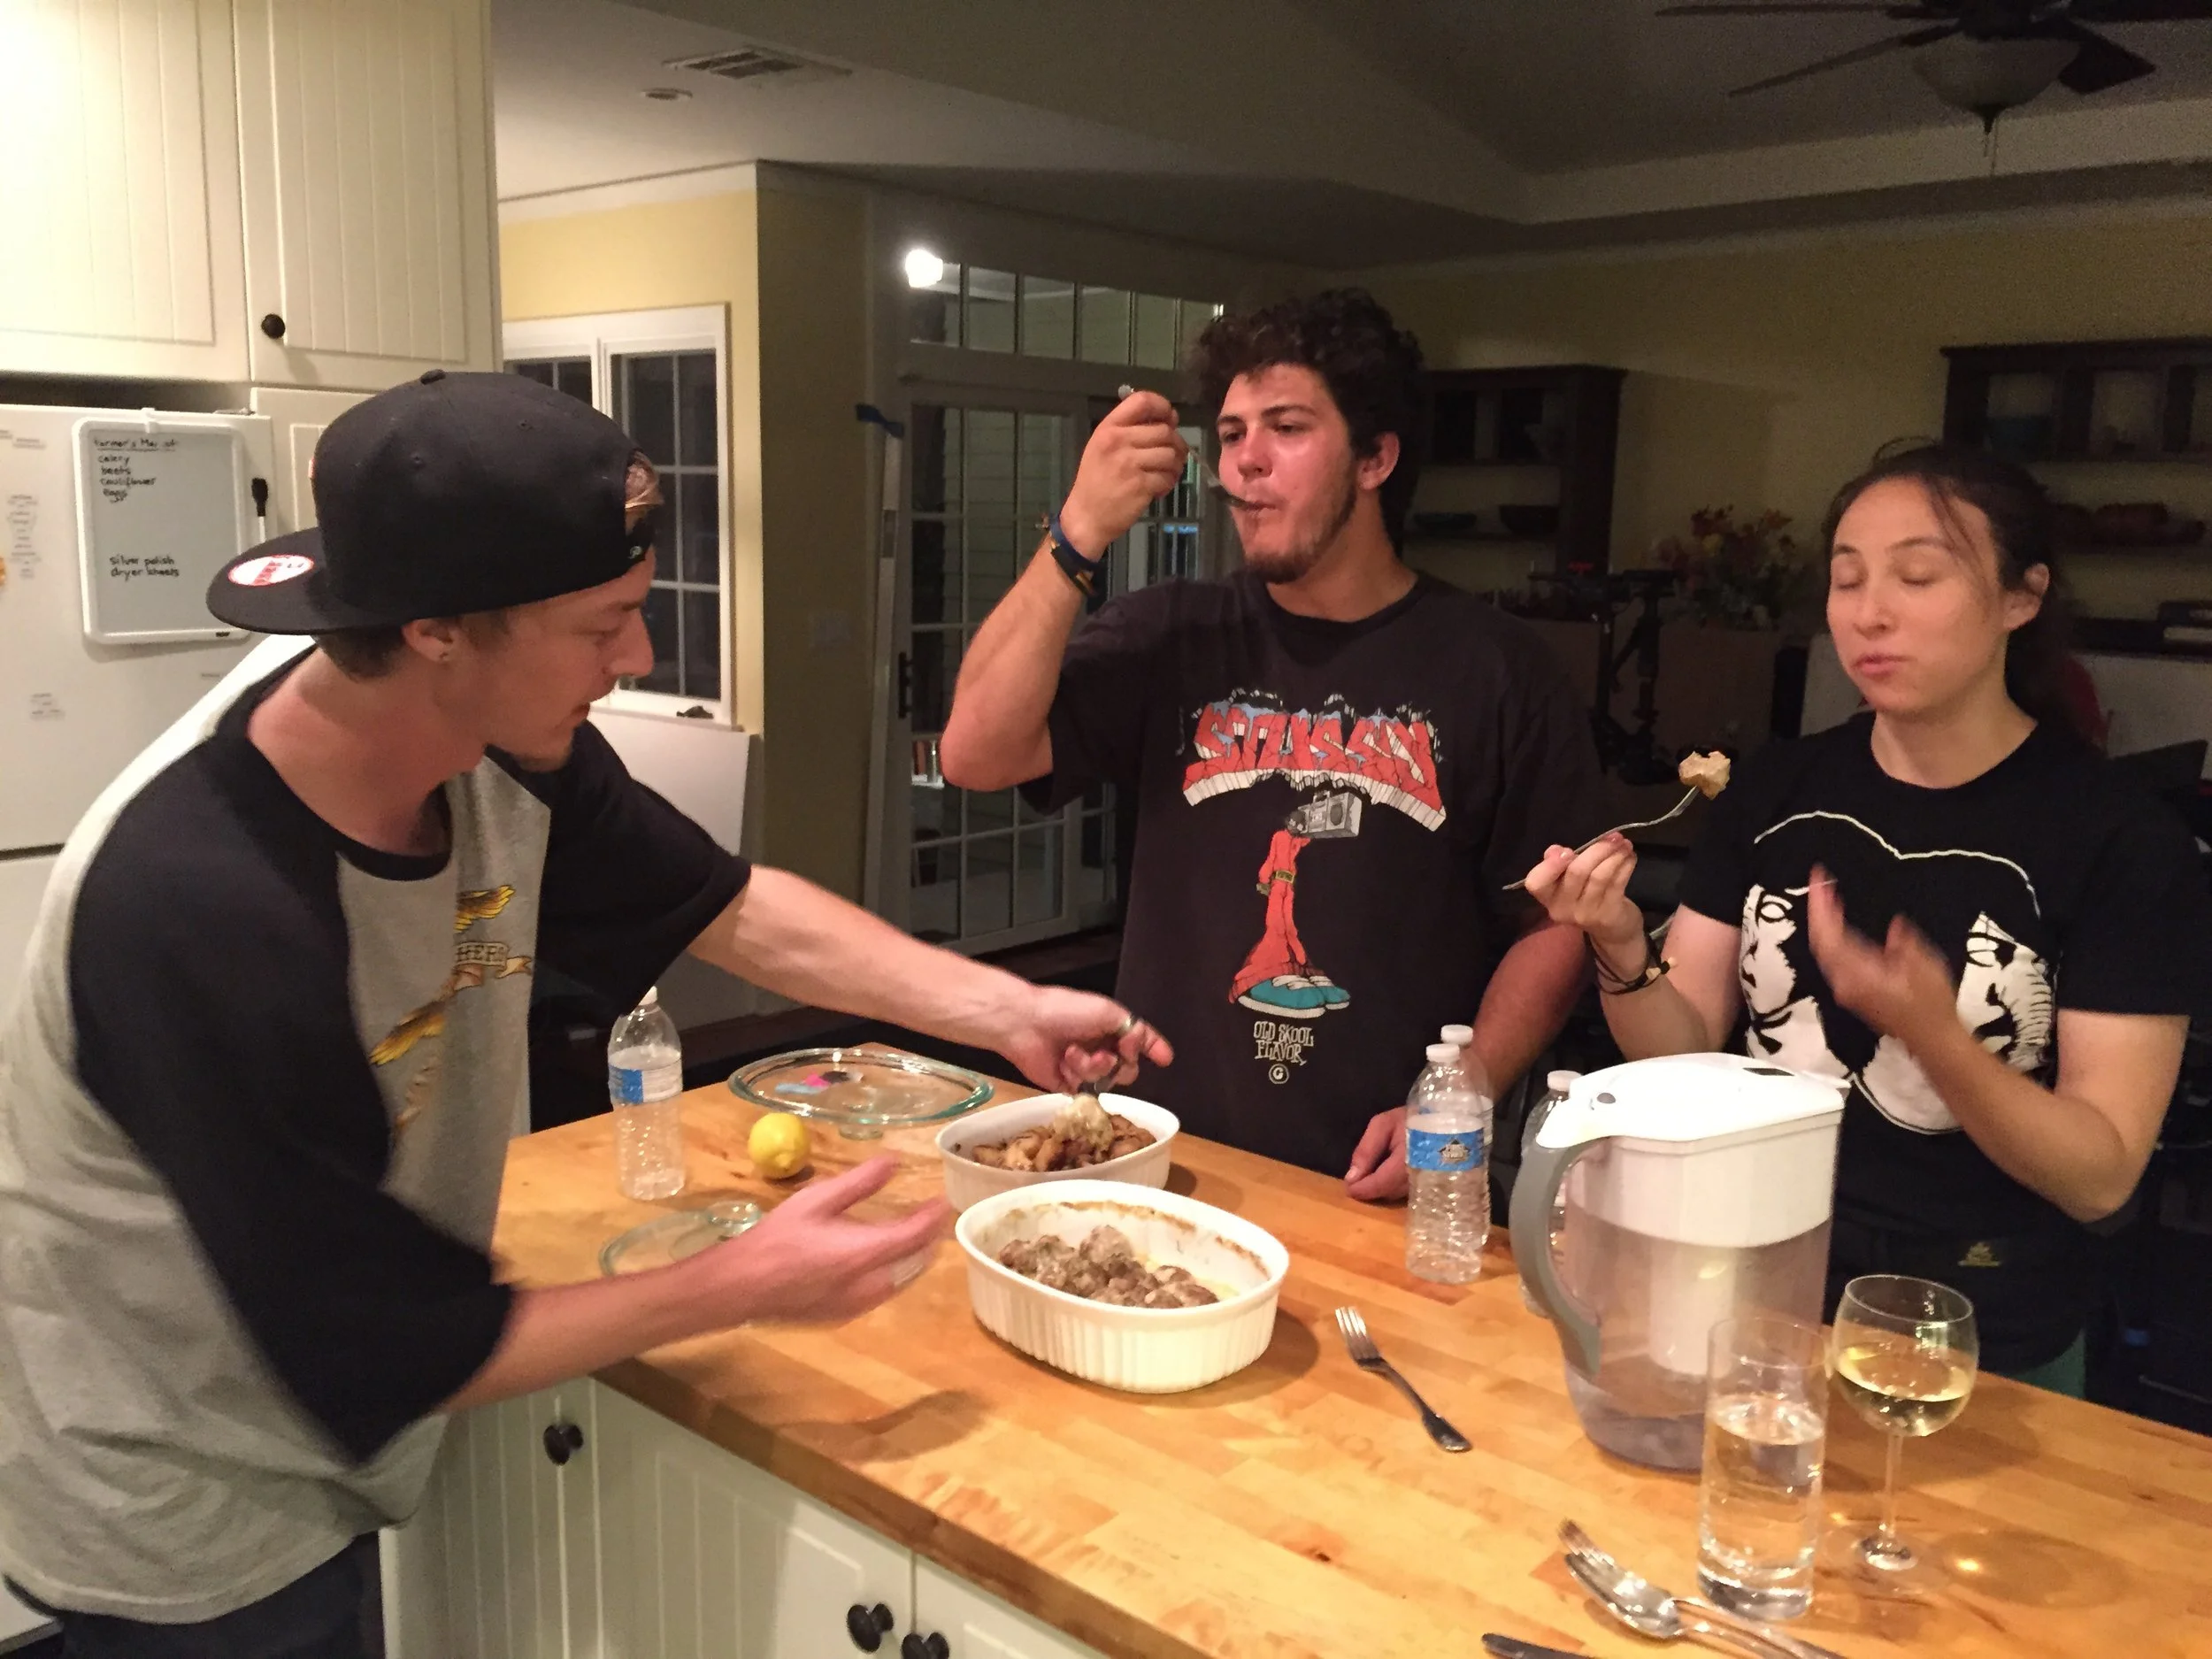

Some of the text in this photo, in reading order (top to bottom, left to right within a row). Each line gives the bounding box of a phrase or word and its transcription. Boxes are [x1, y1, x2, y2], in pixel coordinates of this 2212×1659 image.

[1253, 1020, 1315, 1048] OLD SKOOL
[1255, 1040, 1308, 1066] FLAVOR
